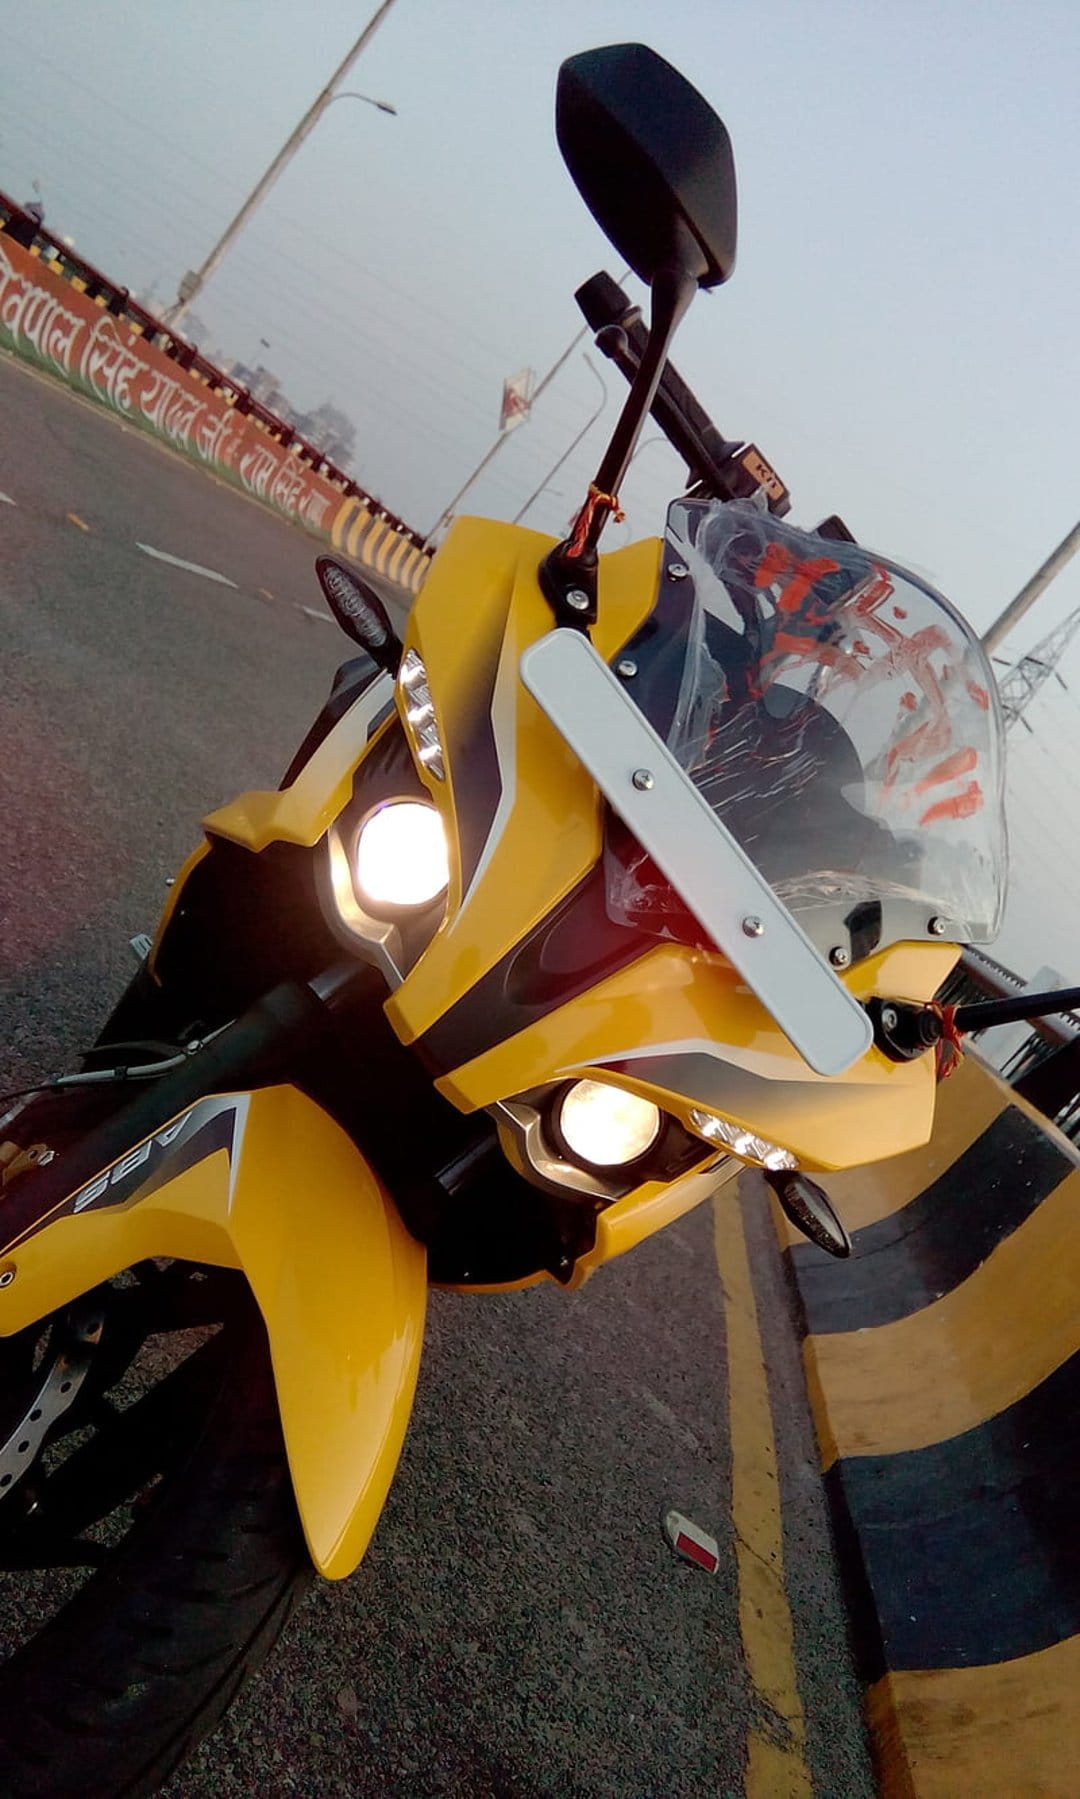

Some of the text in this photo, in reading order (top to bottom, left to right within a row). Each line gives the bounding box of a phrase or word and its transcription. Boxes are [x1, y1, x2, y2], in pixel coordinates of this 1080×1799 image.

[80, 314, 150, 420] सिंह
[140, 369, 208, 451] यादव
[196, 409, 236, 467] जी
[73, 1111, 193, 1214] ABS
